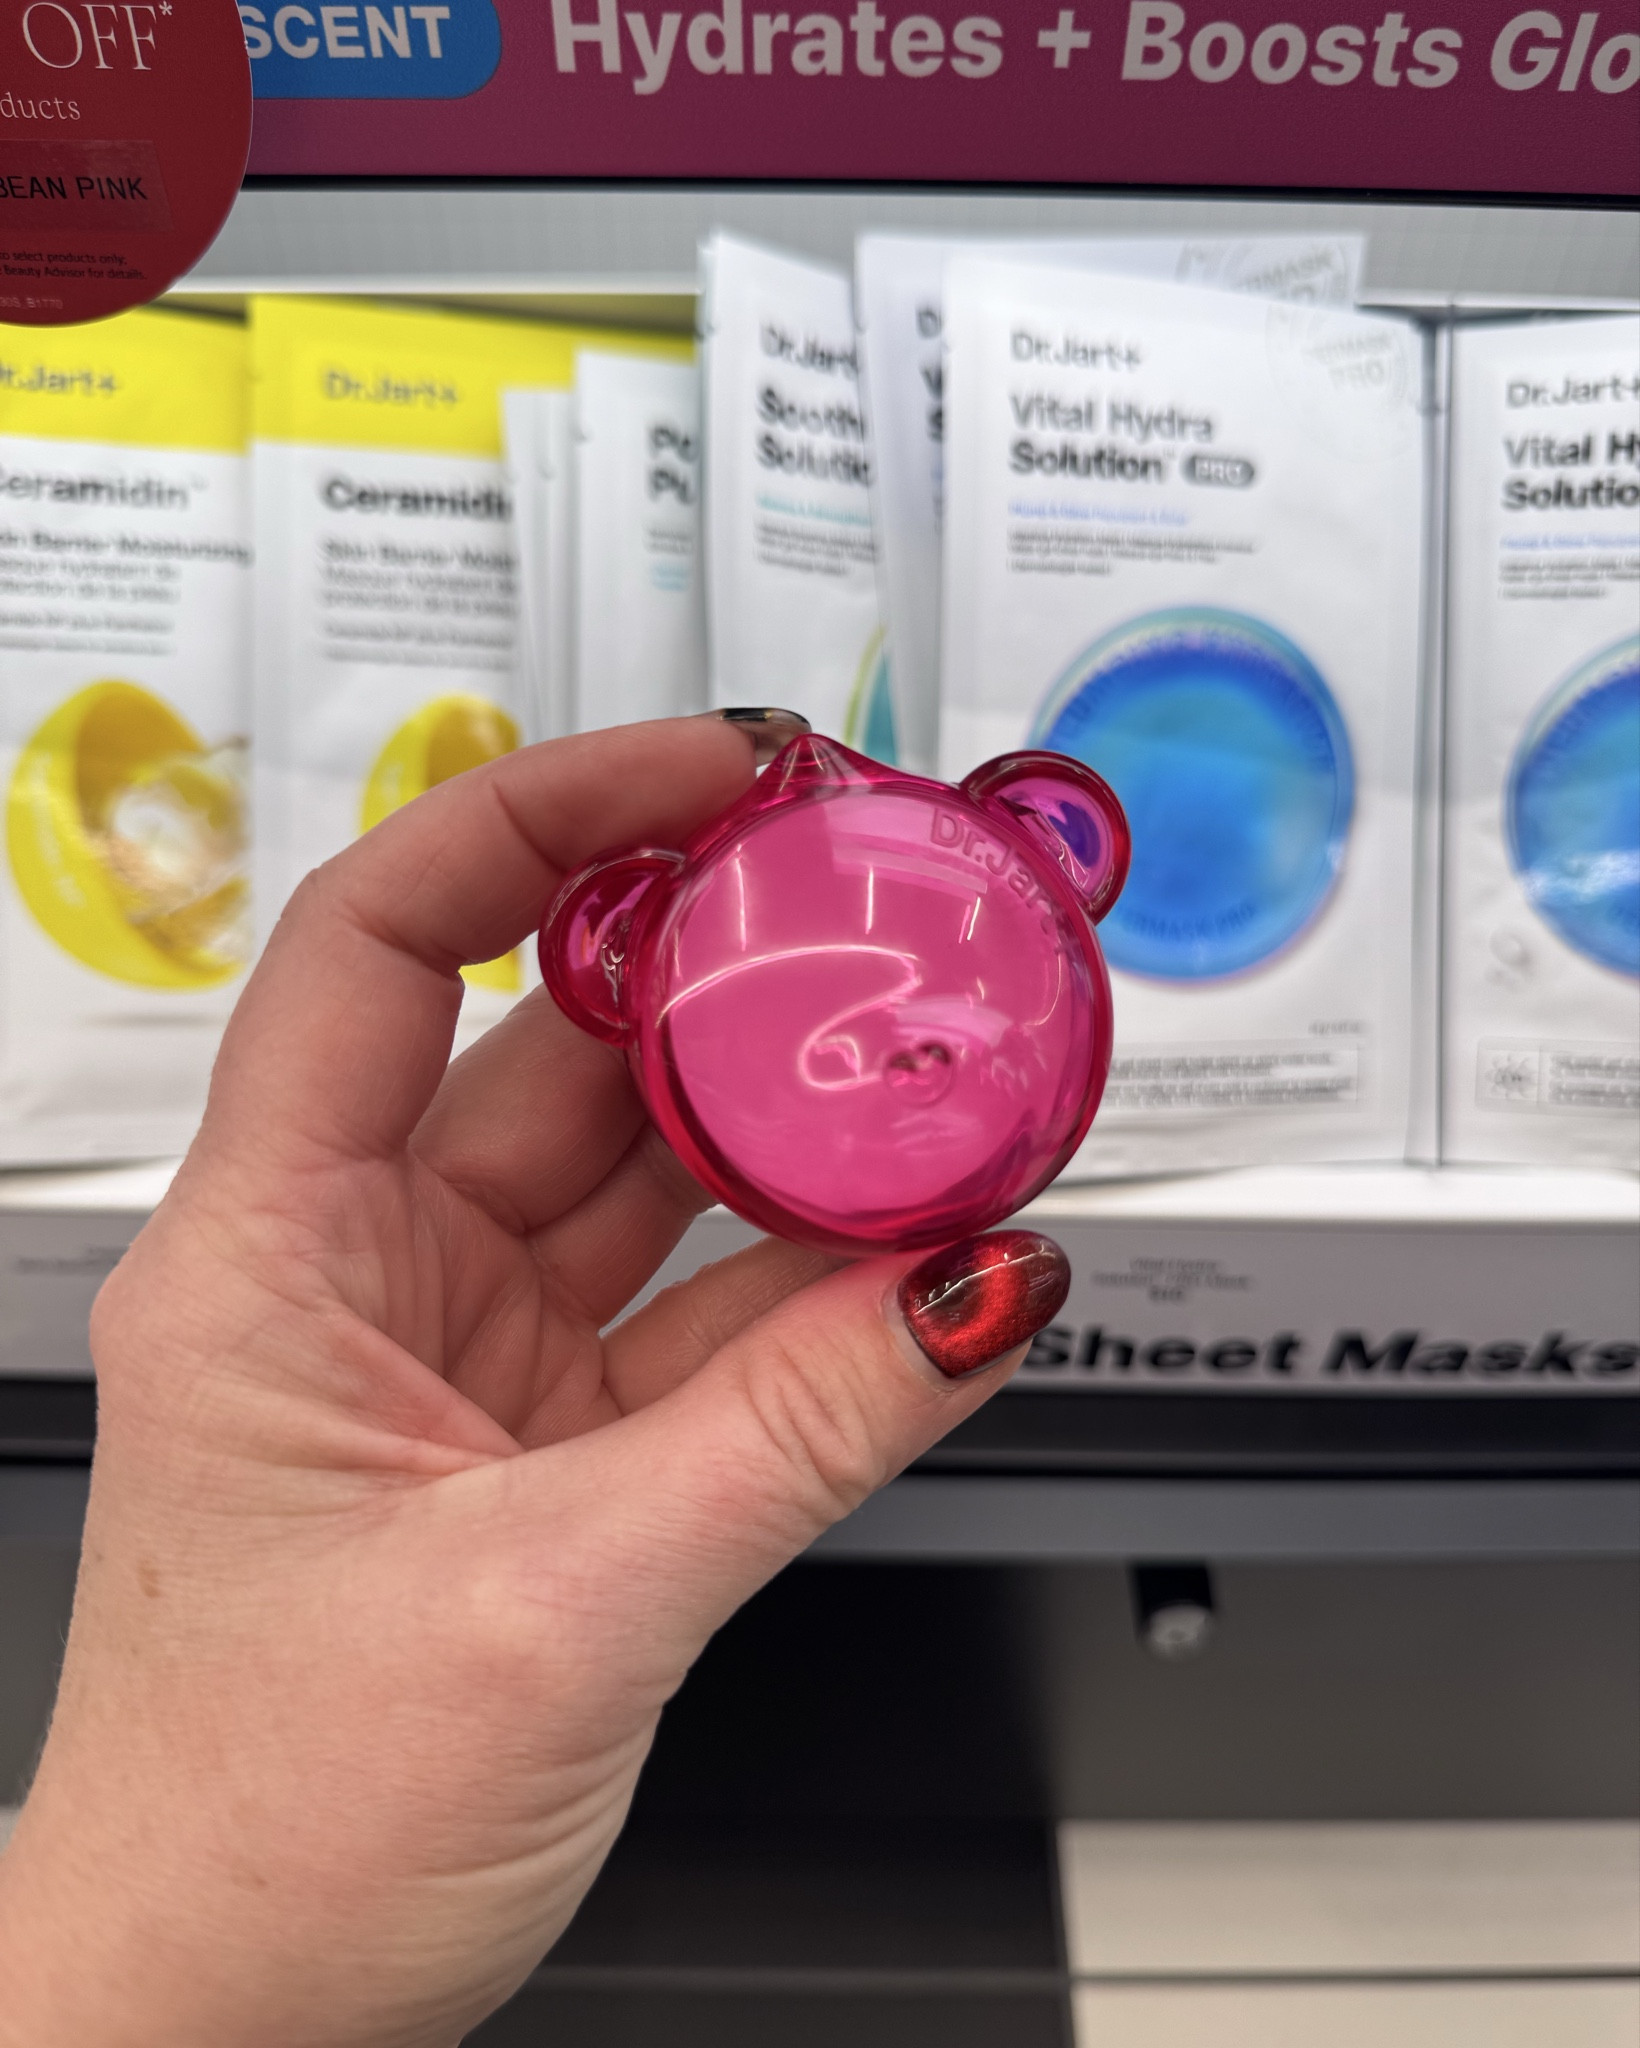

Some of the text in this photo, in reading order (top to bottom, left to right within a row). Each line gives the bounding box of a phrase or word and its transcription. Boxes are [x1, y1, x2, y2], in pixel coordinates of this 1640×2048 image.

[551, 0, 1004, 96] Hydrates
[1120, 0, 1463, 88] Boosts
[75, 176, 149, 200] PINK
[1010, 394, 1215, 444] Vital Hydra
[1009, 440, 1165, 483] Solution
[1502, 432, 1593, 468] Vital
[1026, 1322, 1640, 1376] Sheet Masks
